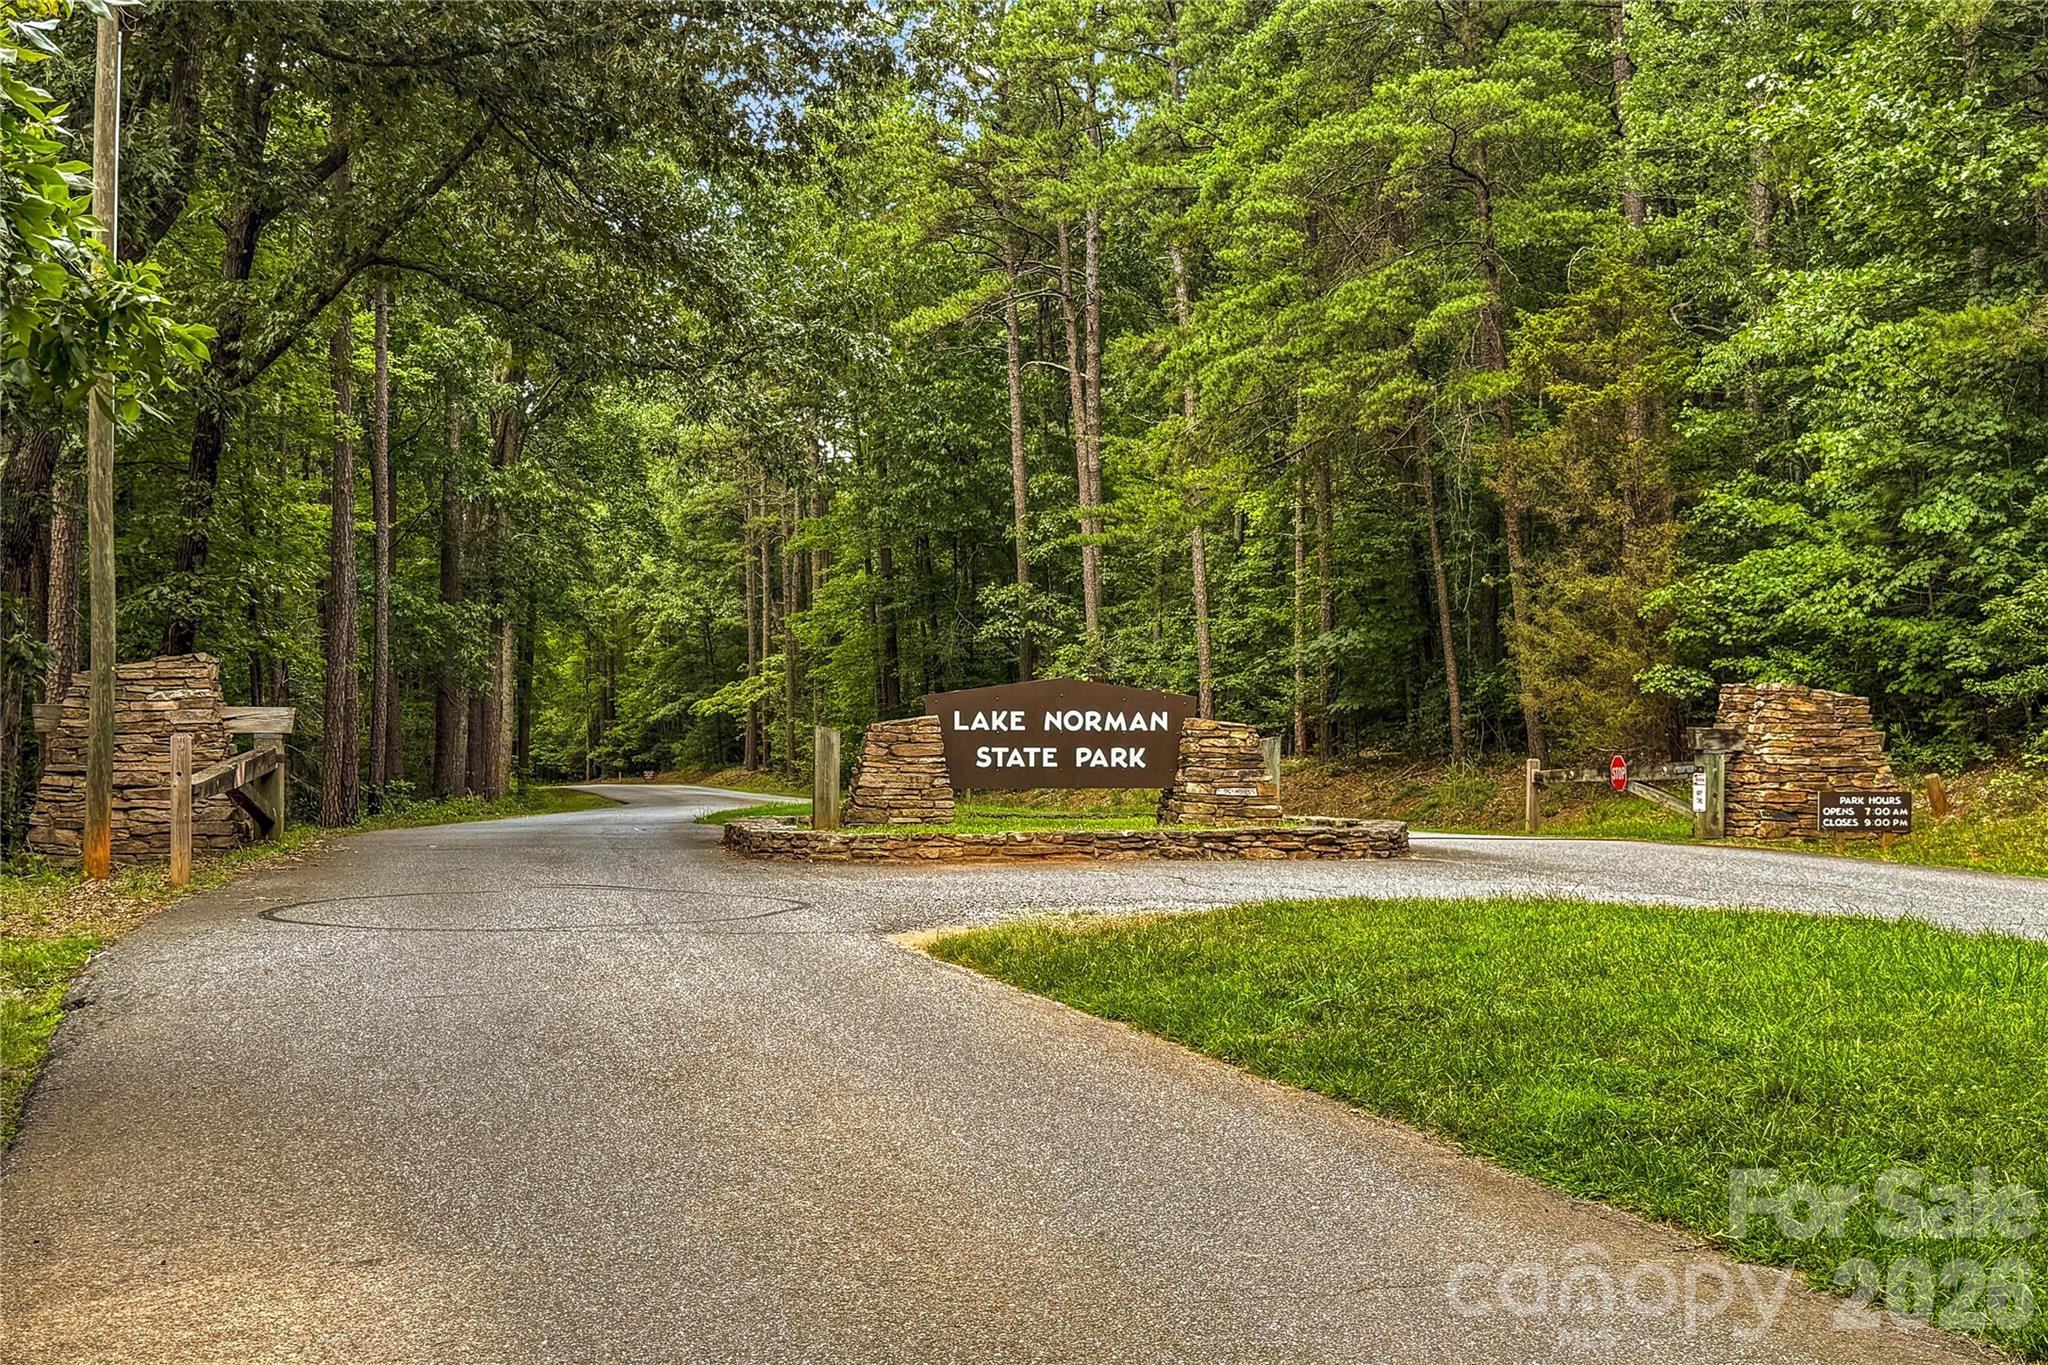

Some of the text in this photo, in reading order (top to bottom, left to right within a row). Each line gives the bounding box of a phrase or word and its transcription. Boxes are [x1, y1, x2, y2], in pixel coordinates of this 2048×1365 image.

[953, 710, 1168, 732] LAKE NORMAN
[975, 746, 1147, 768] STATE PARK
[1611, 767, 1626, 780] STOP
[1839, 796, 1902, 805] PARK HOURS
[1822, 807, 1908, 816] OPENS 7:00 AM
[1822, 818, 1908, 827] CLOSES 9:00 PM
